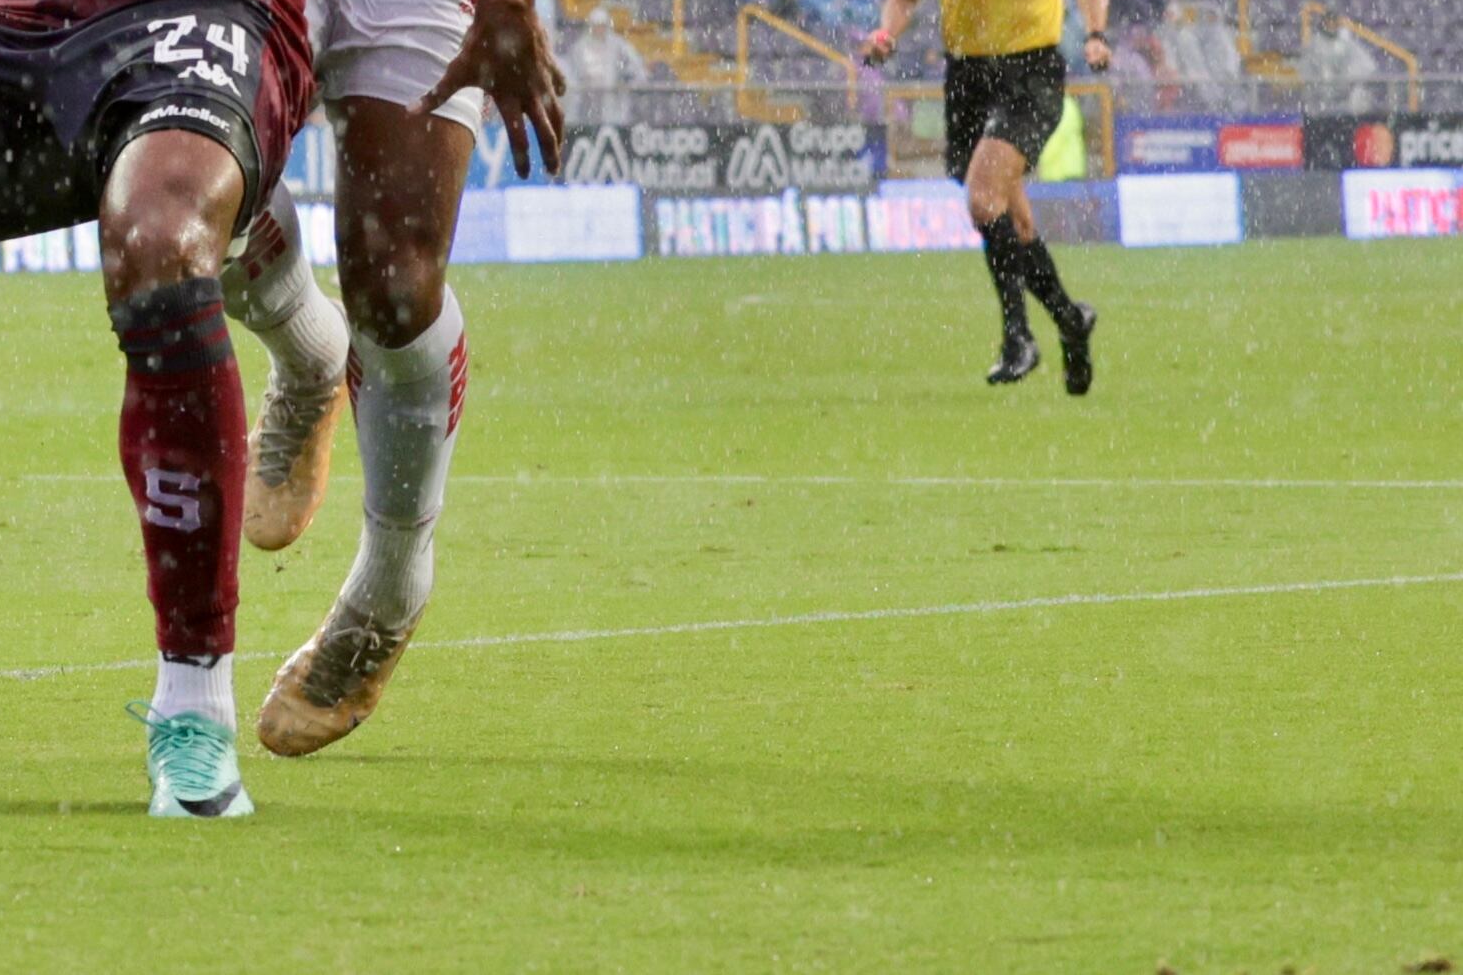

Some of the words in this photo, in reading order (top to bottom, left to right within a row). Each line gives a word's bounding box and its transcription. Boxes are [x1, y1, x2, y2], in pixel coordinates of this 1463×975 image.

[147, 14, 250, 76] 24
[149, 104, 231, 130] Mueller
[632, 125, 708, 155] Grupo
[791, 124, 866, 155] Grupo
